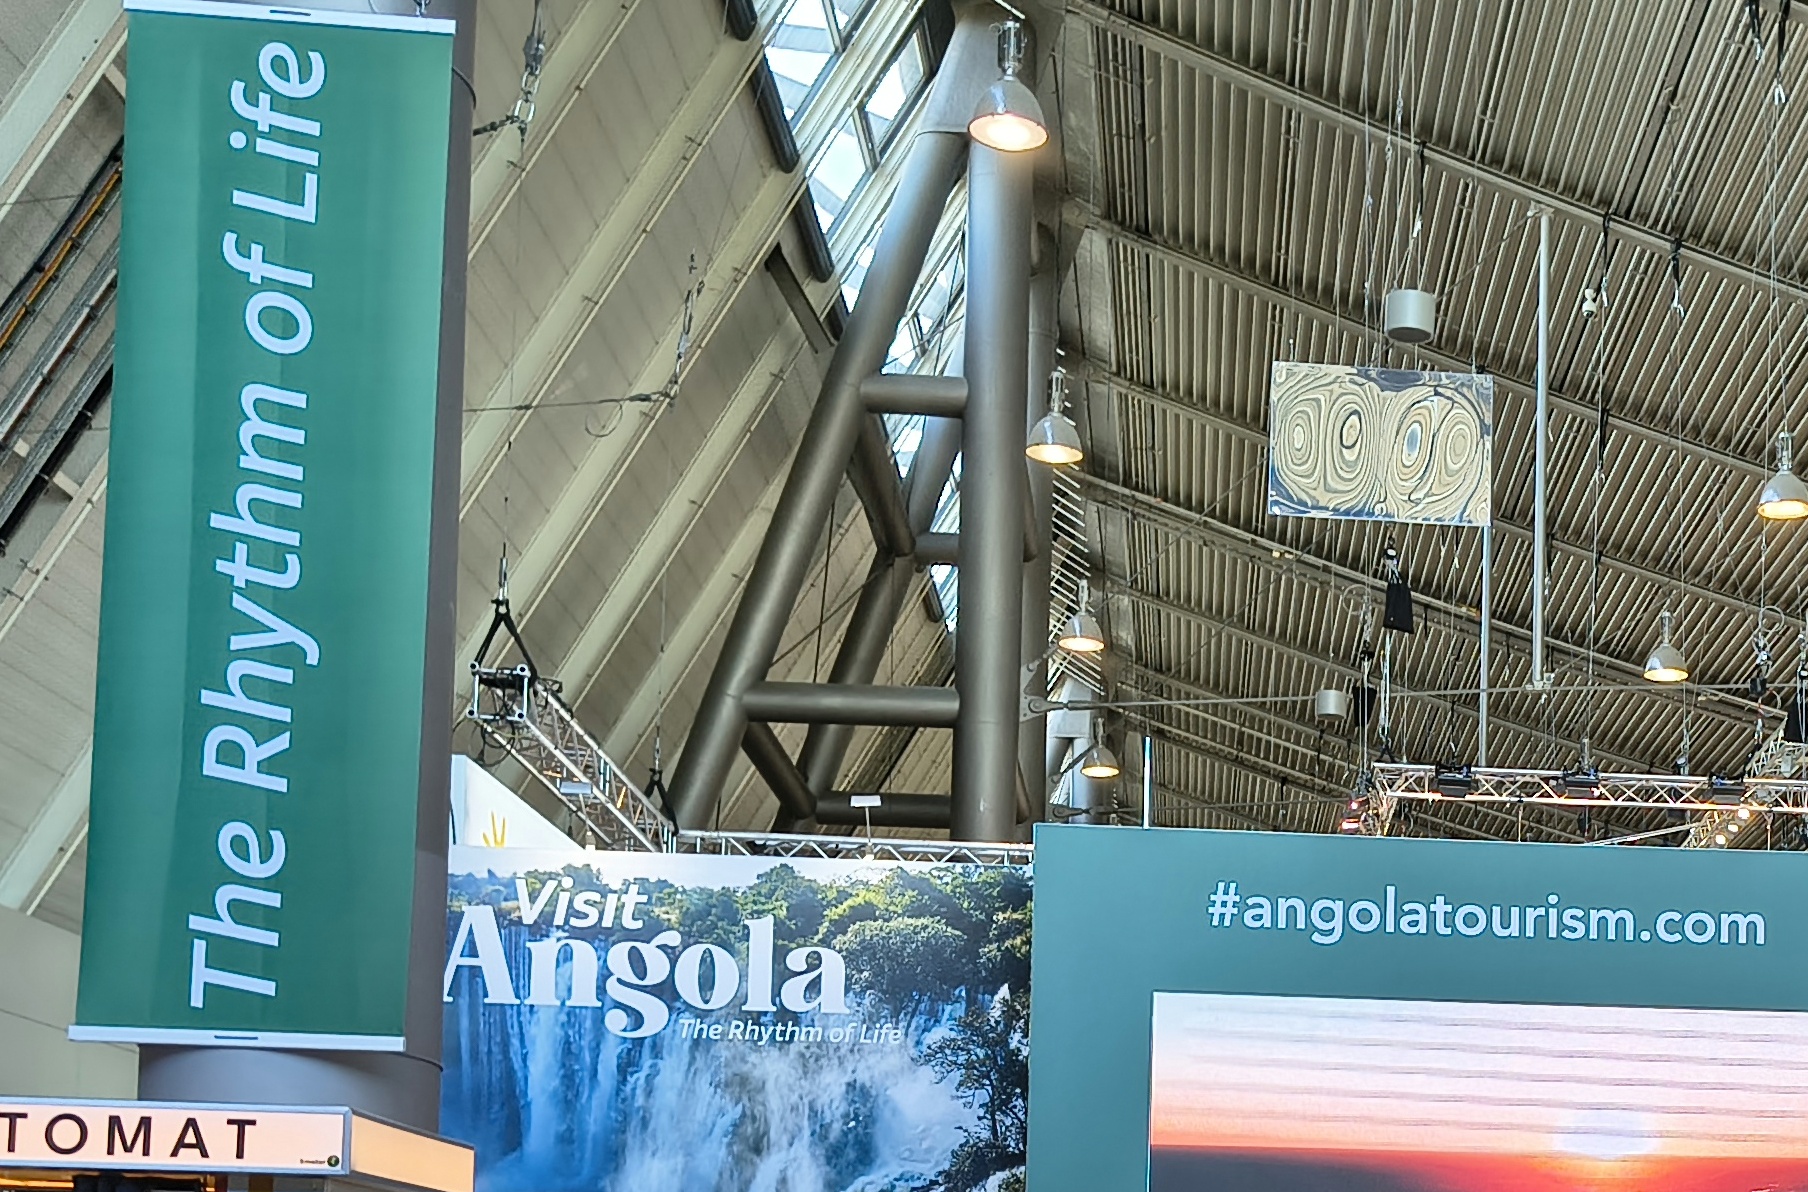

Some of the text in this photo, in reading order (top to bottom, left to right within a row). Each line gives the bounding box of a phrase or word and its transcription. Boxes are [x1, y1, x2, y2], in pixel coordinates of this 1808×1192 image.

[187, 41, 326, 1009] The Rhythm of Life
[514, 877, 648, 931] Visit
[1206, 880, 1767, 947] #angolatourism.com
[442, 904, 851, 1039] Angola
[679, 1017, 902, 1047] The Rhythm of Life
[0, 1112, 258, 1161] TOMAT
